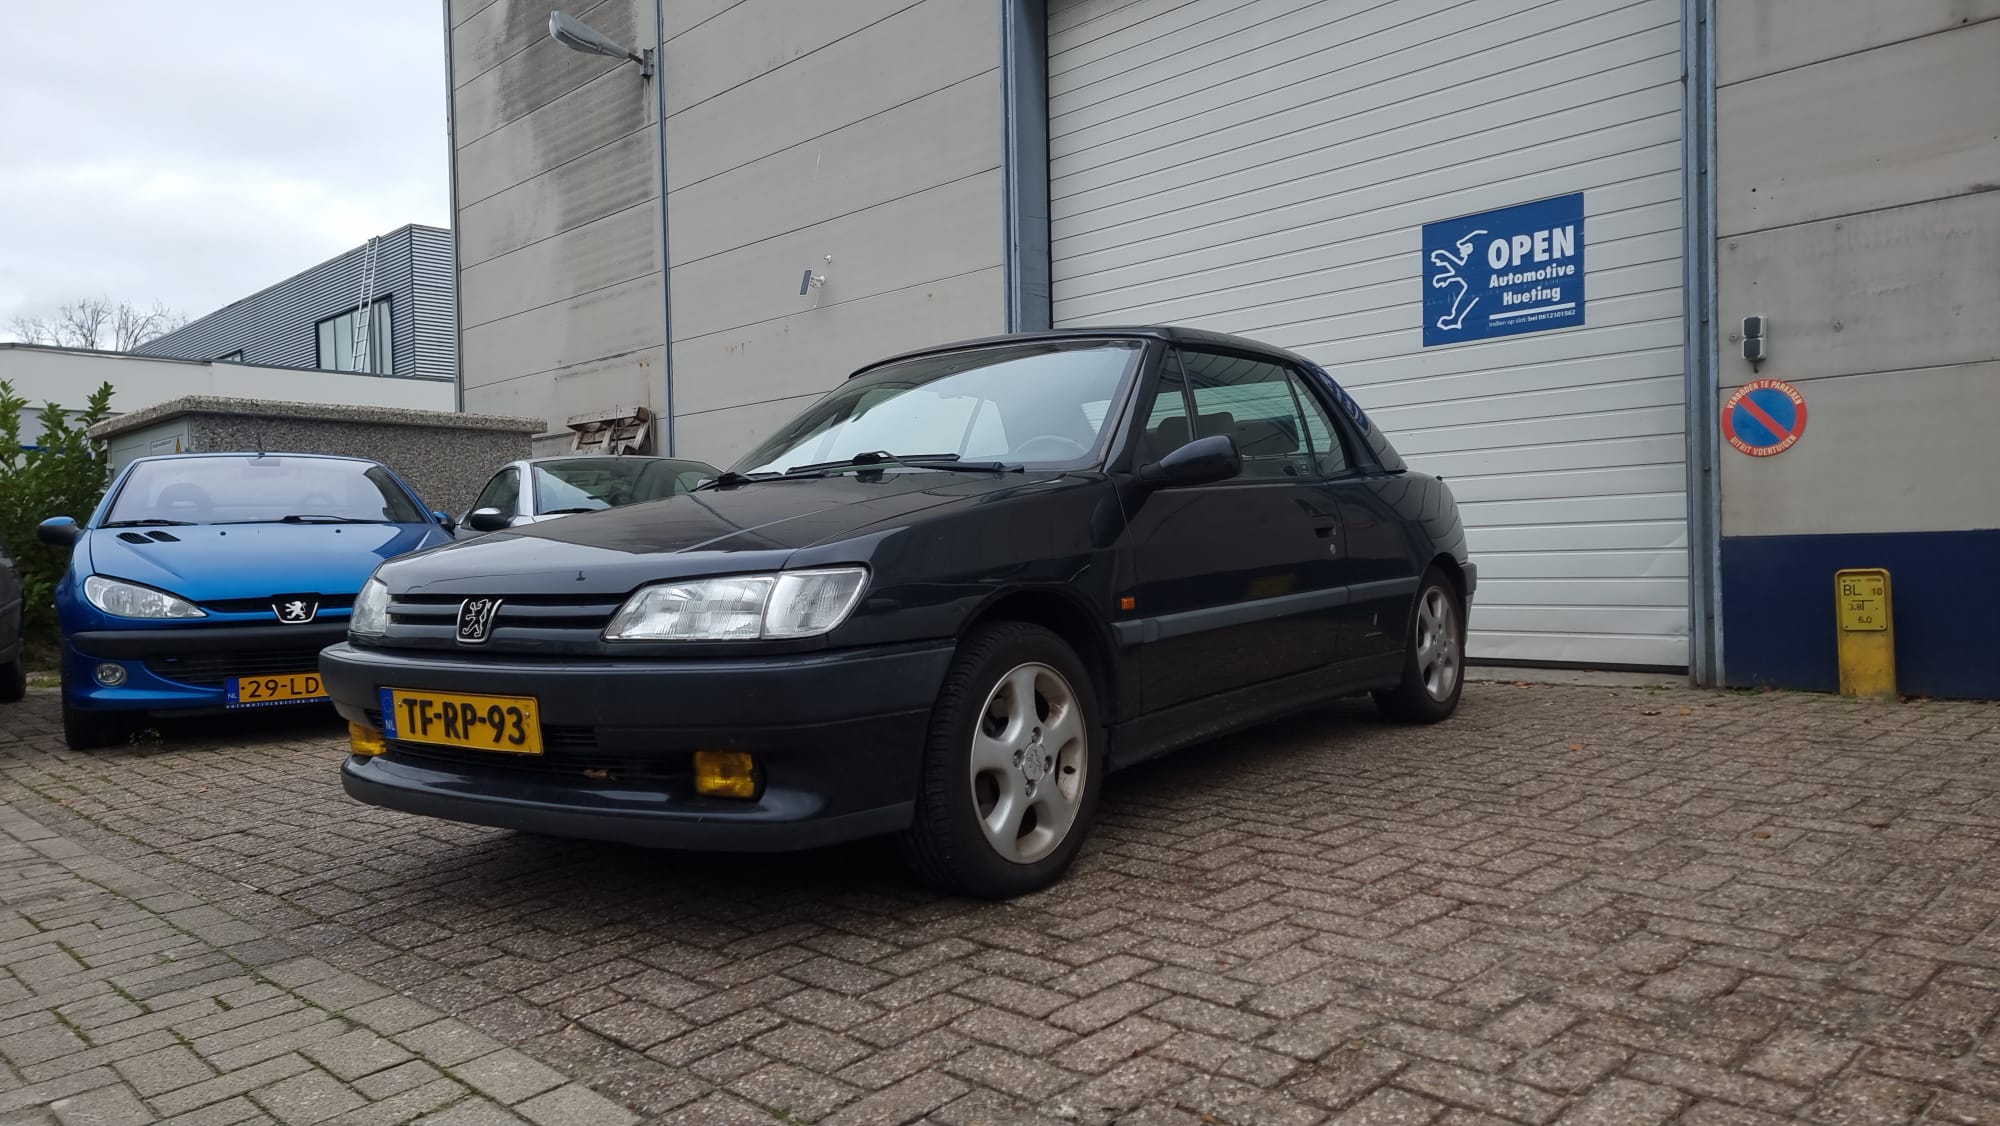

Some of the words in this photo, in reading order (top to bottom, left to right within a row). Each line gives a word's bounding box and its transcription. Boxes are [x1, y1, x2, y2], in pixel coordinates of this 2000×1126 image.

[1488, 225, 1575, 270] OPEN
[1489, 263, 1575, 289] Automotive
[1503, 286, 1561, 306] Hueting
[1726, 382, 1759, 409] VERBODEN
[1760, 380, 1770, 388] TE
[1771, 380, 1803, 406] PARKEREN
[1753, 433, 1798, 456] VOERTUIGEN
[1843, 584, 1863, 596] BL
[247, 677, 319, 698] 29-LD
[385, 720, 396, 731] NL
[402, 698, 526, 745] TF-RP-93
